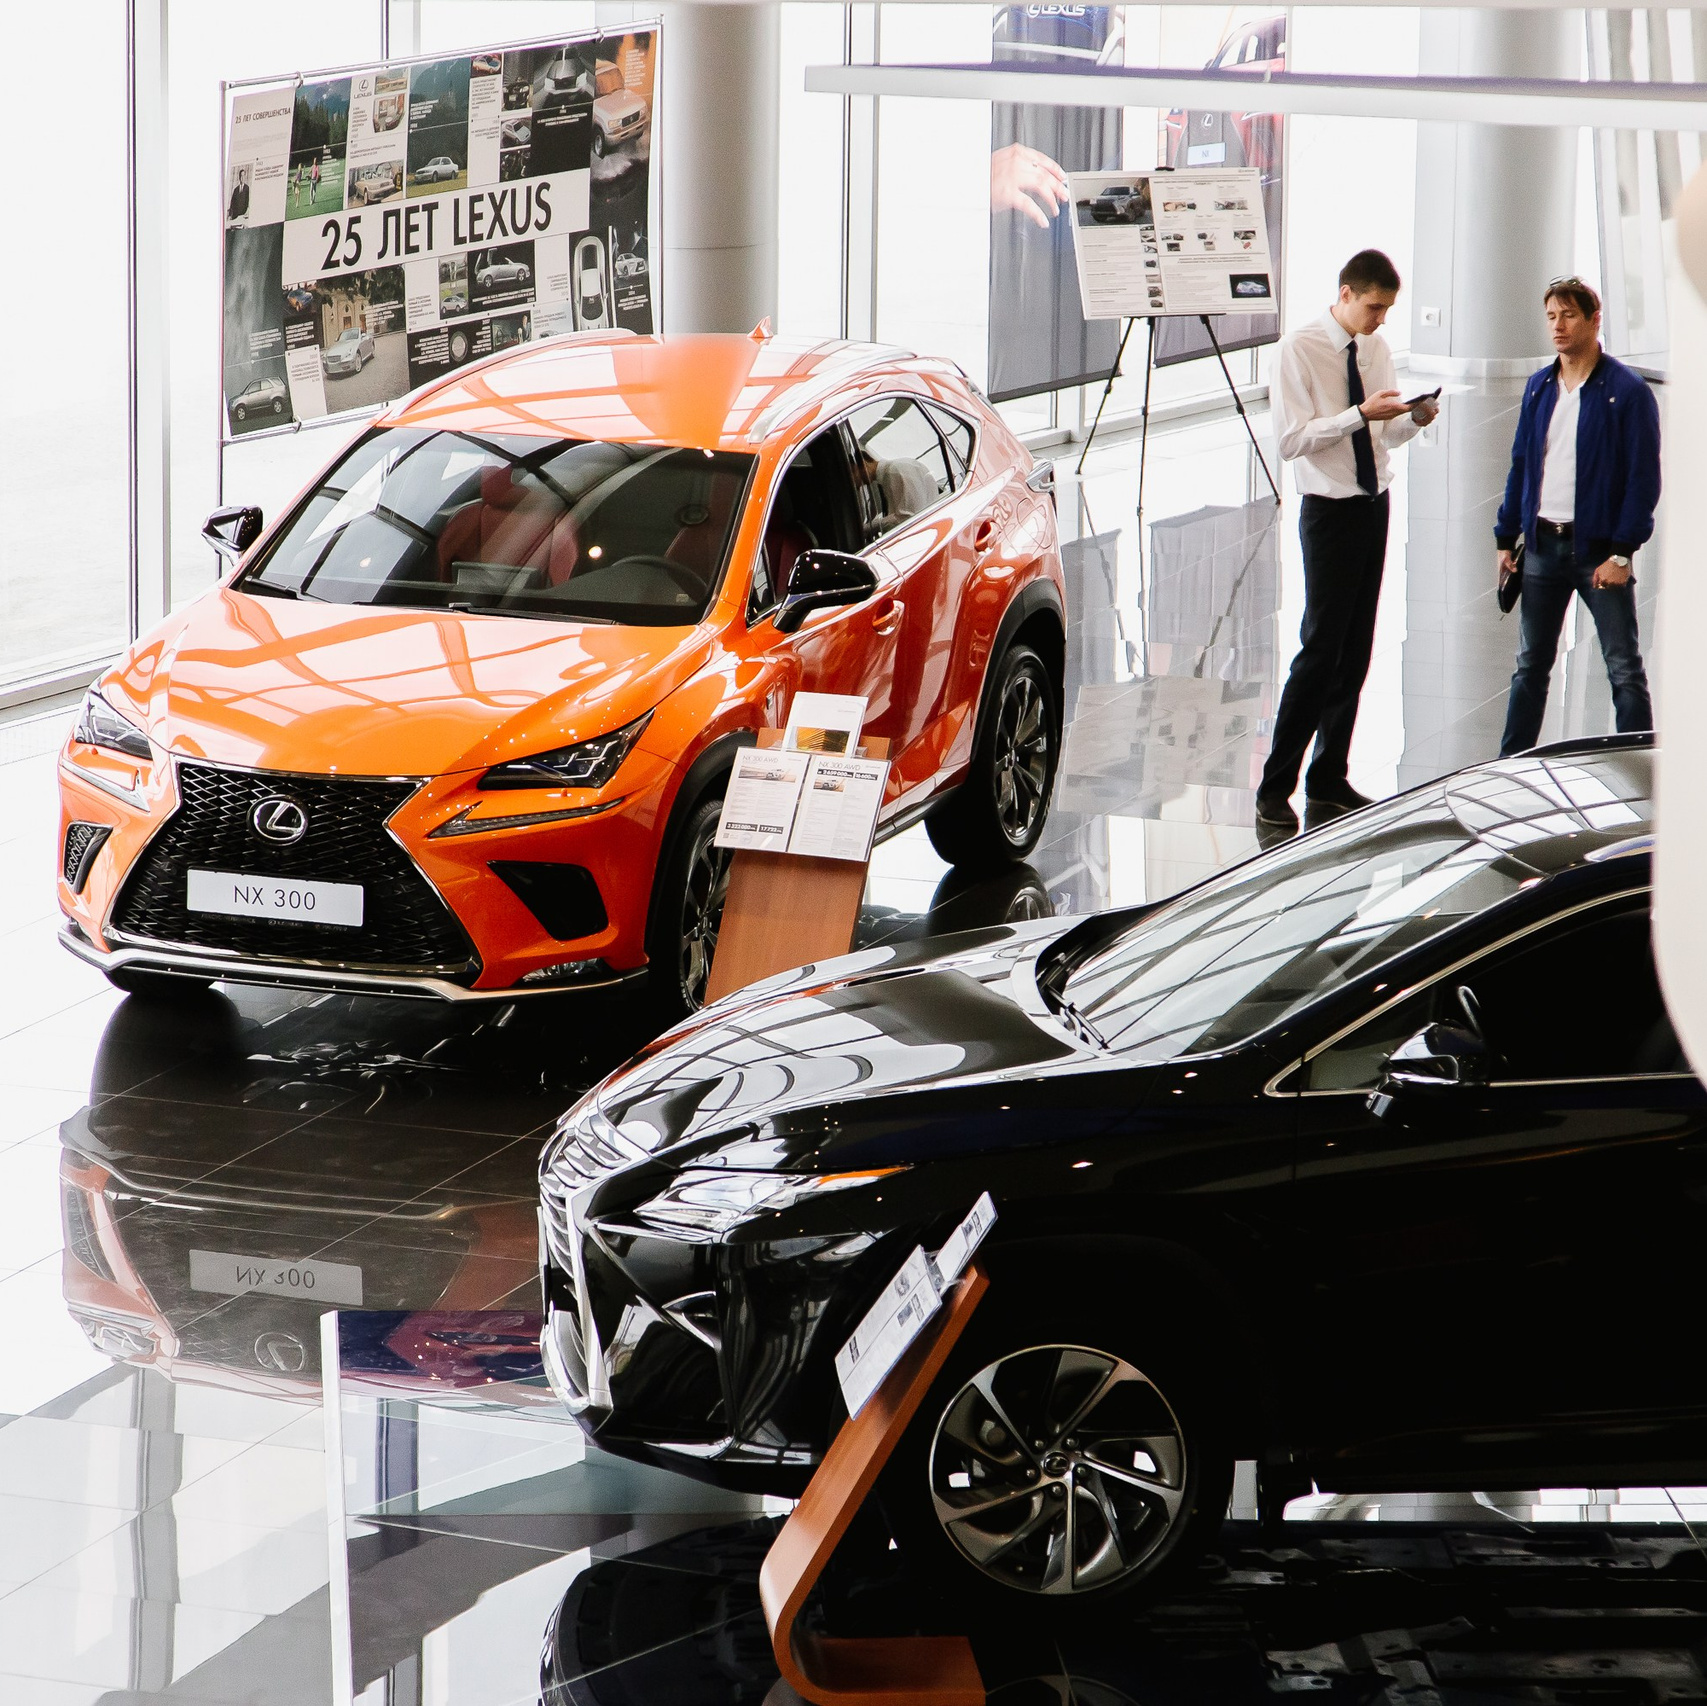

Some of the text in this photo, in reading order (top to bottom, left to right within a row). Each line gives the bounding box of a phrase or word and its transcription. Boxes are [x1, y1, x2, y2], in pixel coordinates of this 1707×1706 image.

[321, 182, 552, 270] 25 ЛЕТ LEXUS
[234, 886, 316, 910] NX 300
